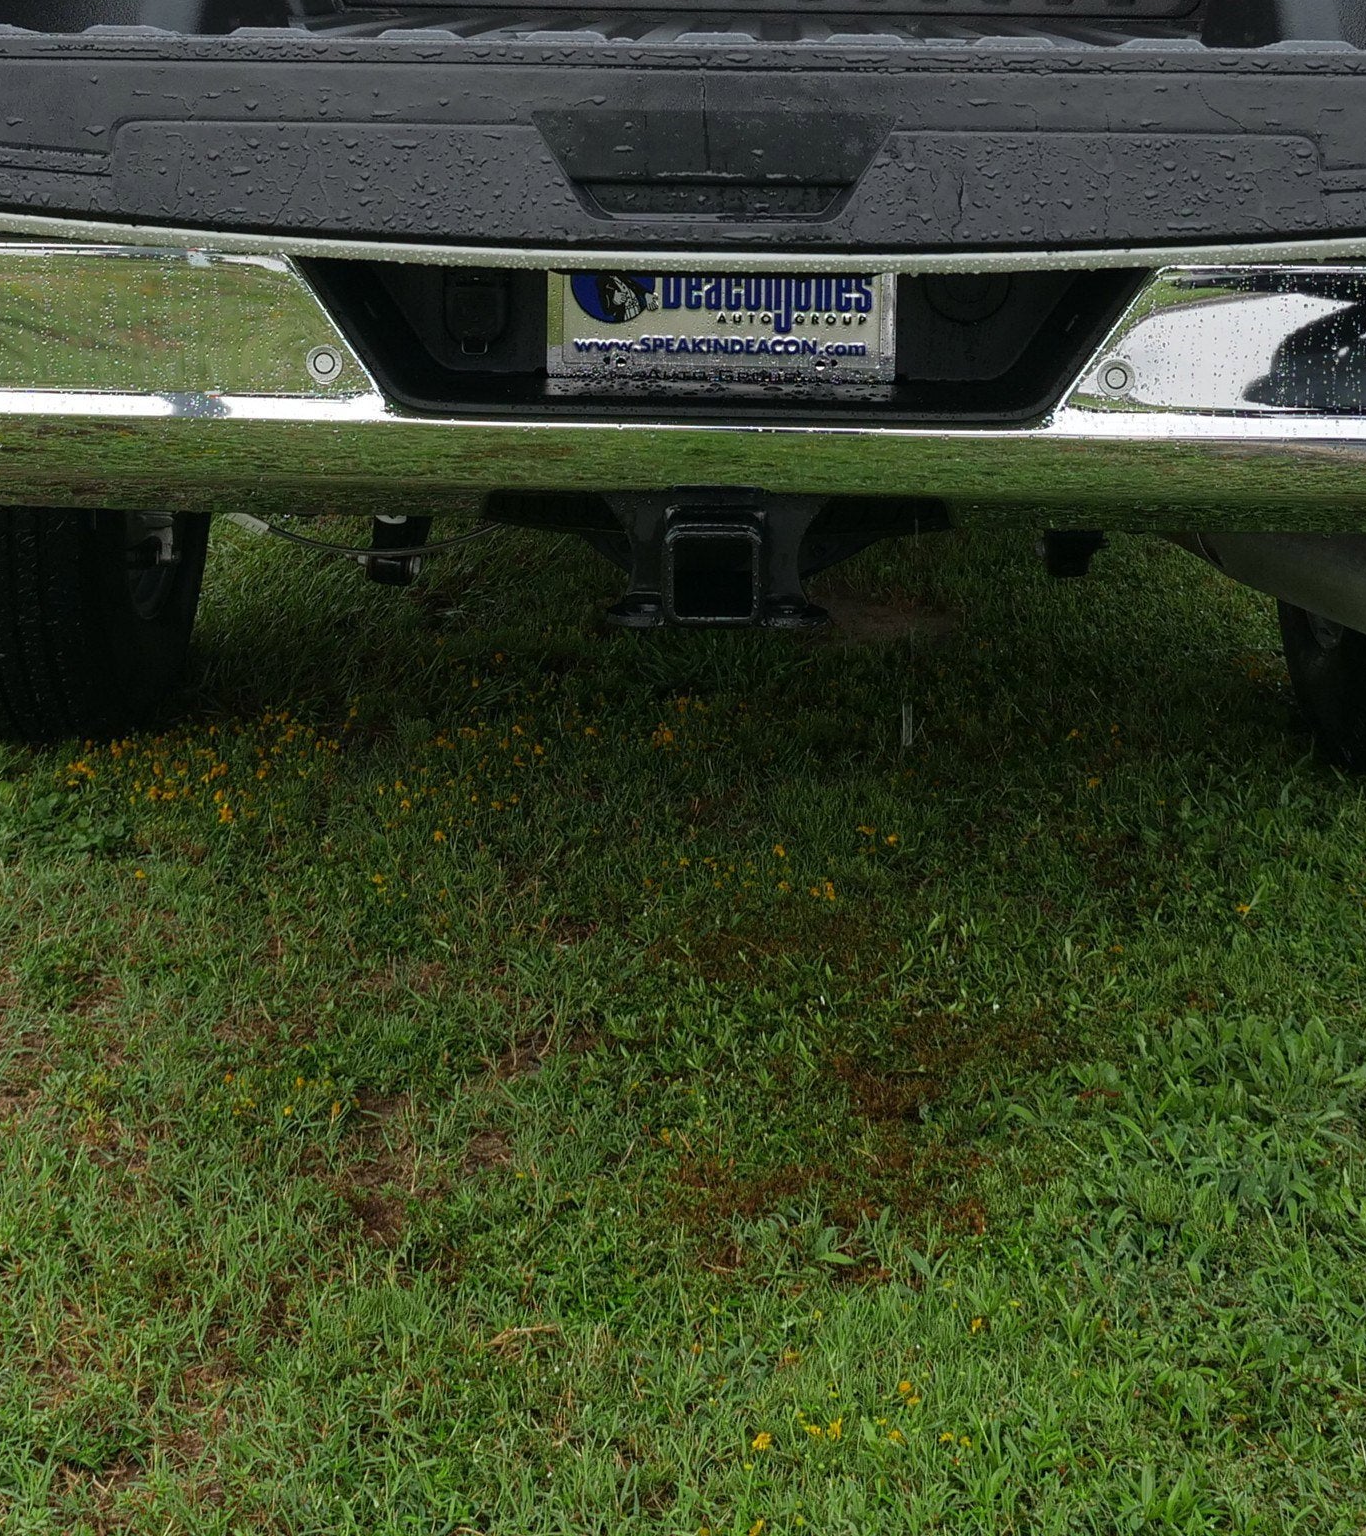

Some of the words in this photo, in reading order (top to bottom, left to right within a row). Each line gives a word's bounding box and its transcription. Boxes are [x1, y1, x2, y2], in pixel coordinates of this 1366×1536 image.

[716, 312, 772, 325] AUTO
[794, 313, 867, 326] GROUP
[573, 335, 867, 357] www.SPEAKINDEACON.com
